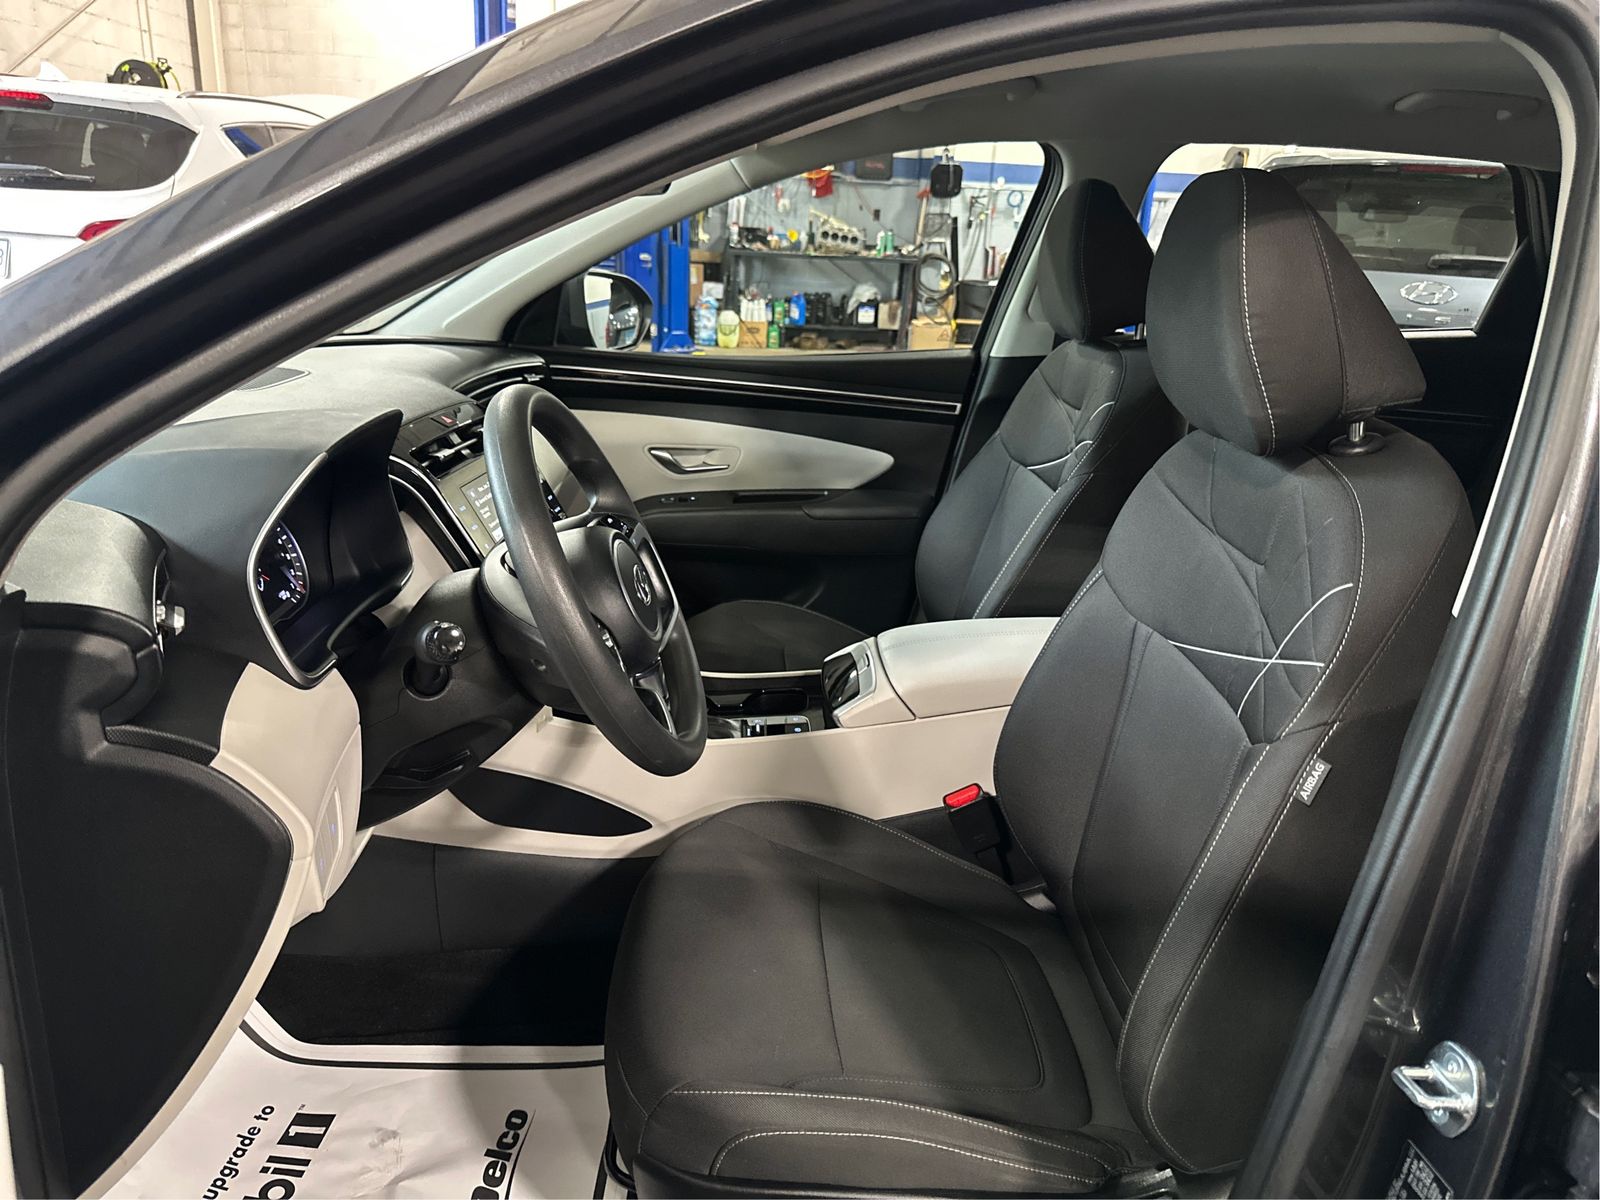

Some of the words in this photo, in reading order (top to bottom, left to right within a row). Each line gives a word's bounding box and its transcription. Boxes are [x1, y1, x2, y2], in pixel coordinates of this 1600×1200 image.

[1300, 762, 1325, 801] AIRBAG
[202, 1126, 261, 1200] upgrade
[253, 1105, 275, 1121] to
